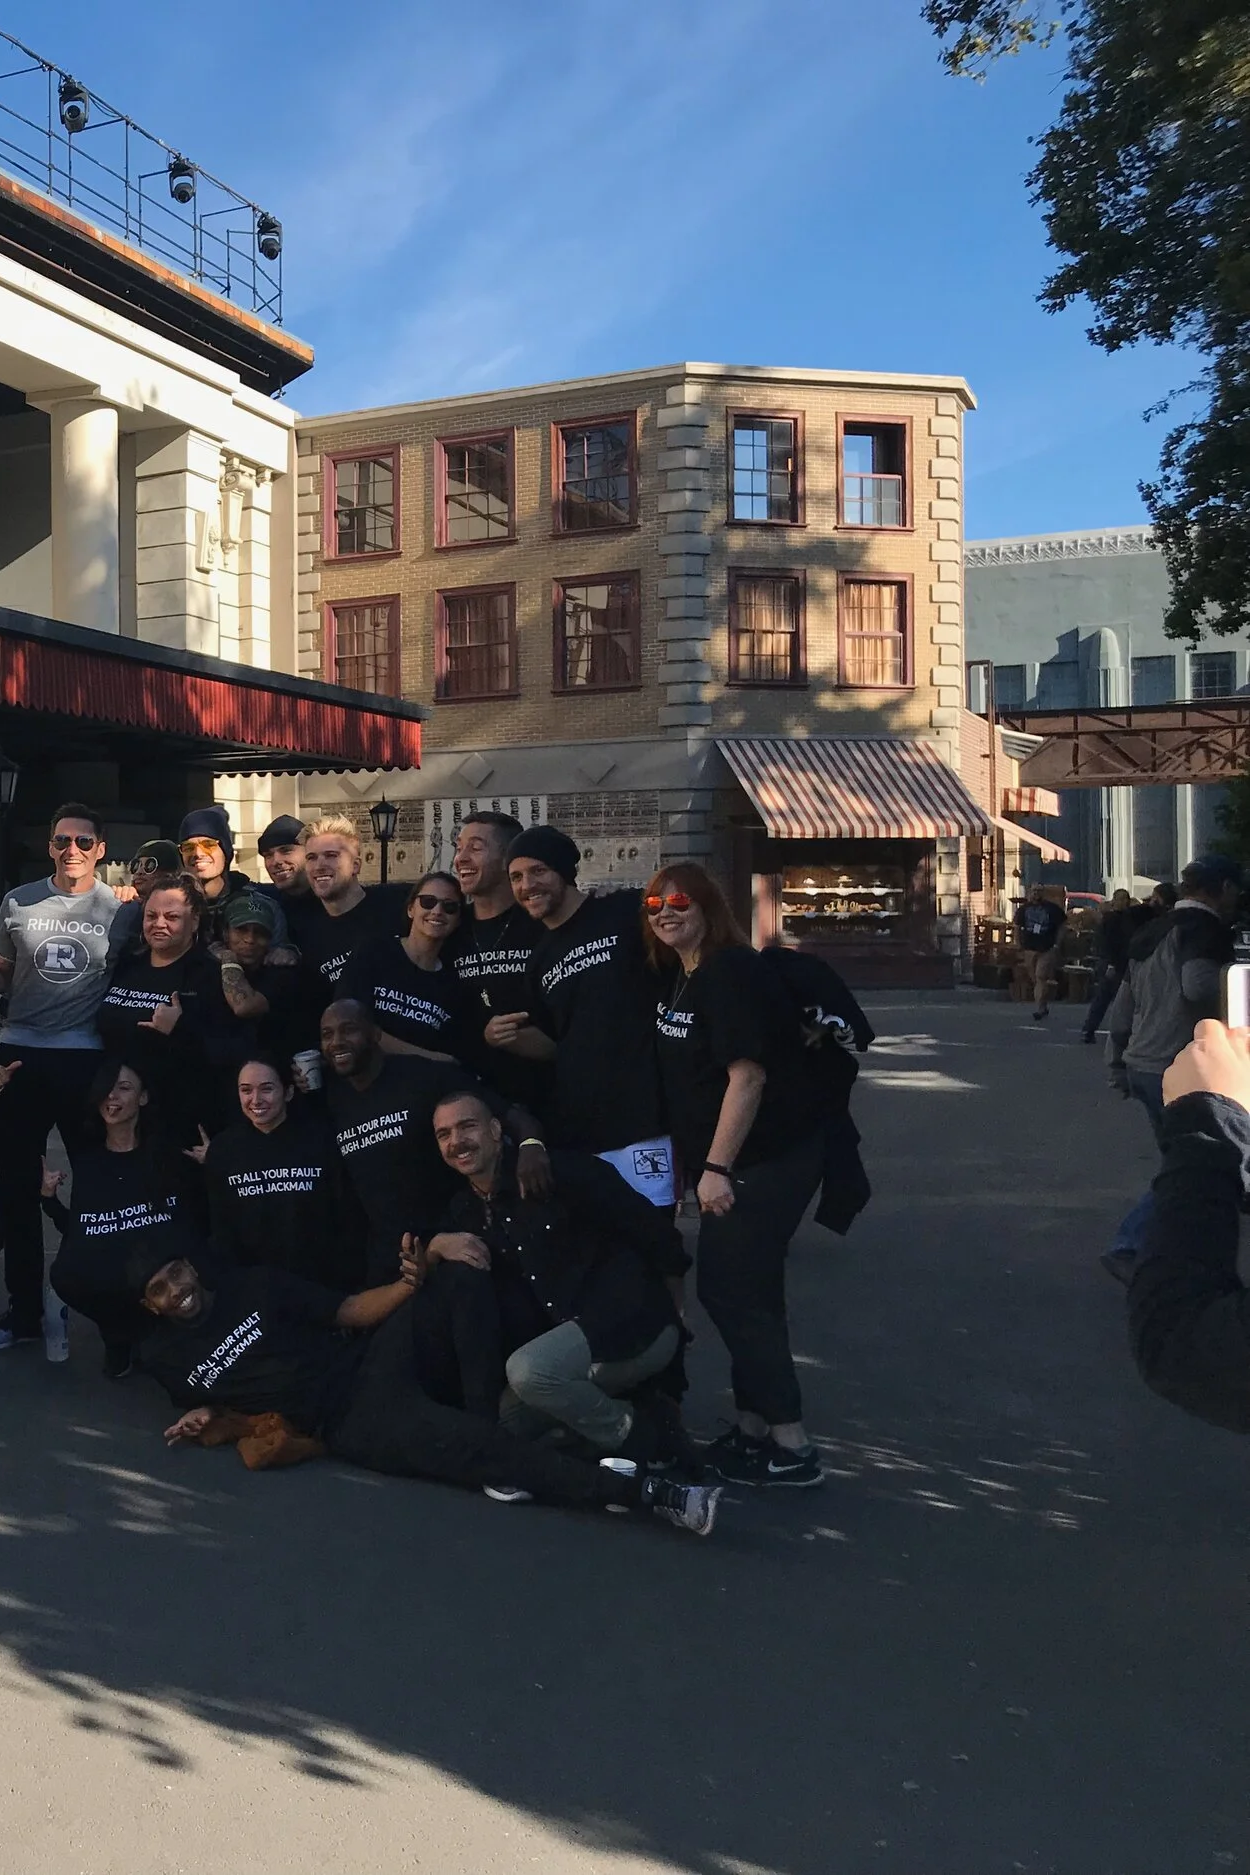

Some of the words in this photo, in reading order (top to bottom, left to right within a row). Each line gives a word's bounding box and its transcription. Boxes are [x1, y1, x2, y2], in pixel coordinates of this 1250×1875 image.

[27, 918, 105, 936] RHINOCO
[586, 935, 618, 953] FAULT
[332, 954, 346, 968] ALL
[464, 953, 478, 965] ALL
[479, 950, 506, 962] YOUR
[563, 950, 611, 978] JACKMAN
[458, 966, 480, 979] HUGH
[128, 990, 150, 1000] YOUR
[149, 993, 172, 1003] FAUL
[387, 989, 404, 1002] ALL
[406, 994, 431, 1011] YOUR
[375, 1000, 403, 1015] HUGH
[343, 1127, 357, 1140] ALL
[356, 1118, 379, 1135] YOUR
[379, 1110, 409, 1127] FAULT
[360, 1125, 403, 1149] JACKMAN
[228, 1174, 241, 1186] IT'S
[242, 1171, 261, 1183] ALL
[261, 1168, 289, 1180] YOUR
[290, 1167, 322, 1178] FAULT
[237, 1184, 264, 1197] HUGH
[265, 1181, 313, 1193] JACKMAN
[80, 1213, 97, 1223] IT'S
[97, 1211, 117, 1222] ALL
[118, 1203, 147, 1218] YOUR
[85, 1222, 118, 1235] HUGH
[119, 1213, 171, 1230] JACKMAN
[187, 1370, 201, 1386] IT'S
[196, 1359, 216, 1374] ALL
[211, 1335, 236, 1361] YOUR
[233, 1311, 261, 1339] FAULT
[222, 1327, 263, 1368] JACKMAN
